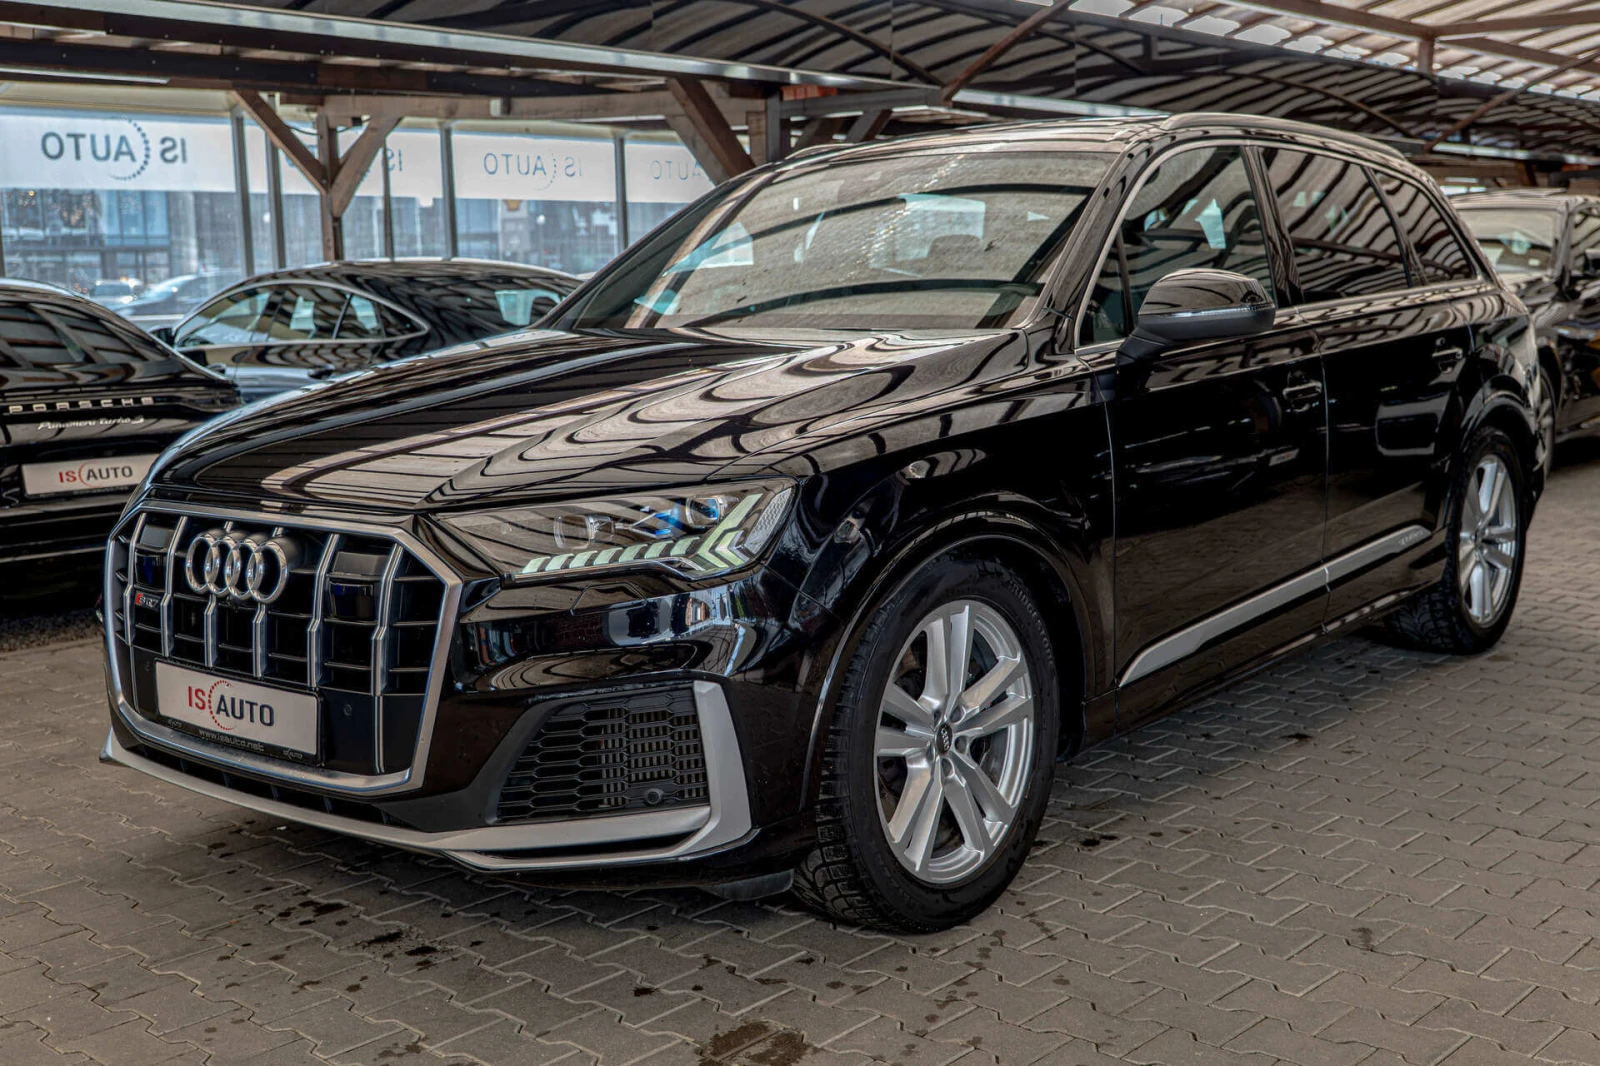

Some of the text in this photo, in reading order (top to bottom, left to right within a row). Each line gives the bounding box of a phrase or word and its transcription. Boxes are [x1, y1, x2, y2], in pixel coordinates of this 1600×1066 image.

[8, 396, 154, 414] PORSCHE
[58, 465, 134, 484] IS AUTO
[187, 685, 206, 711] IS
[216, 694, 275, 727] AUTO
